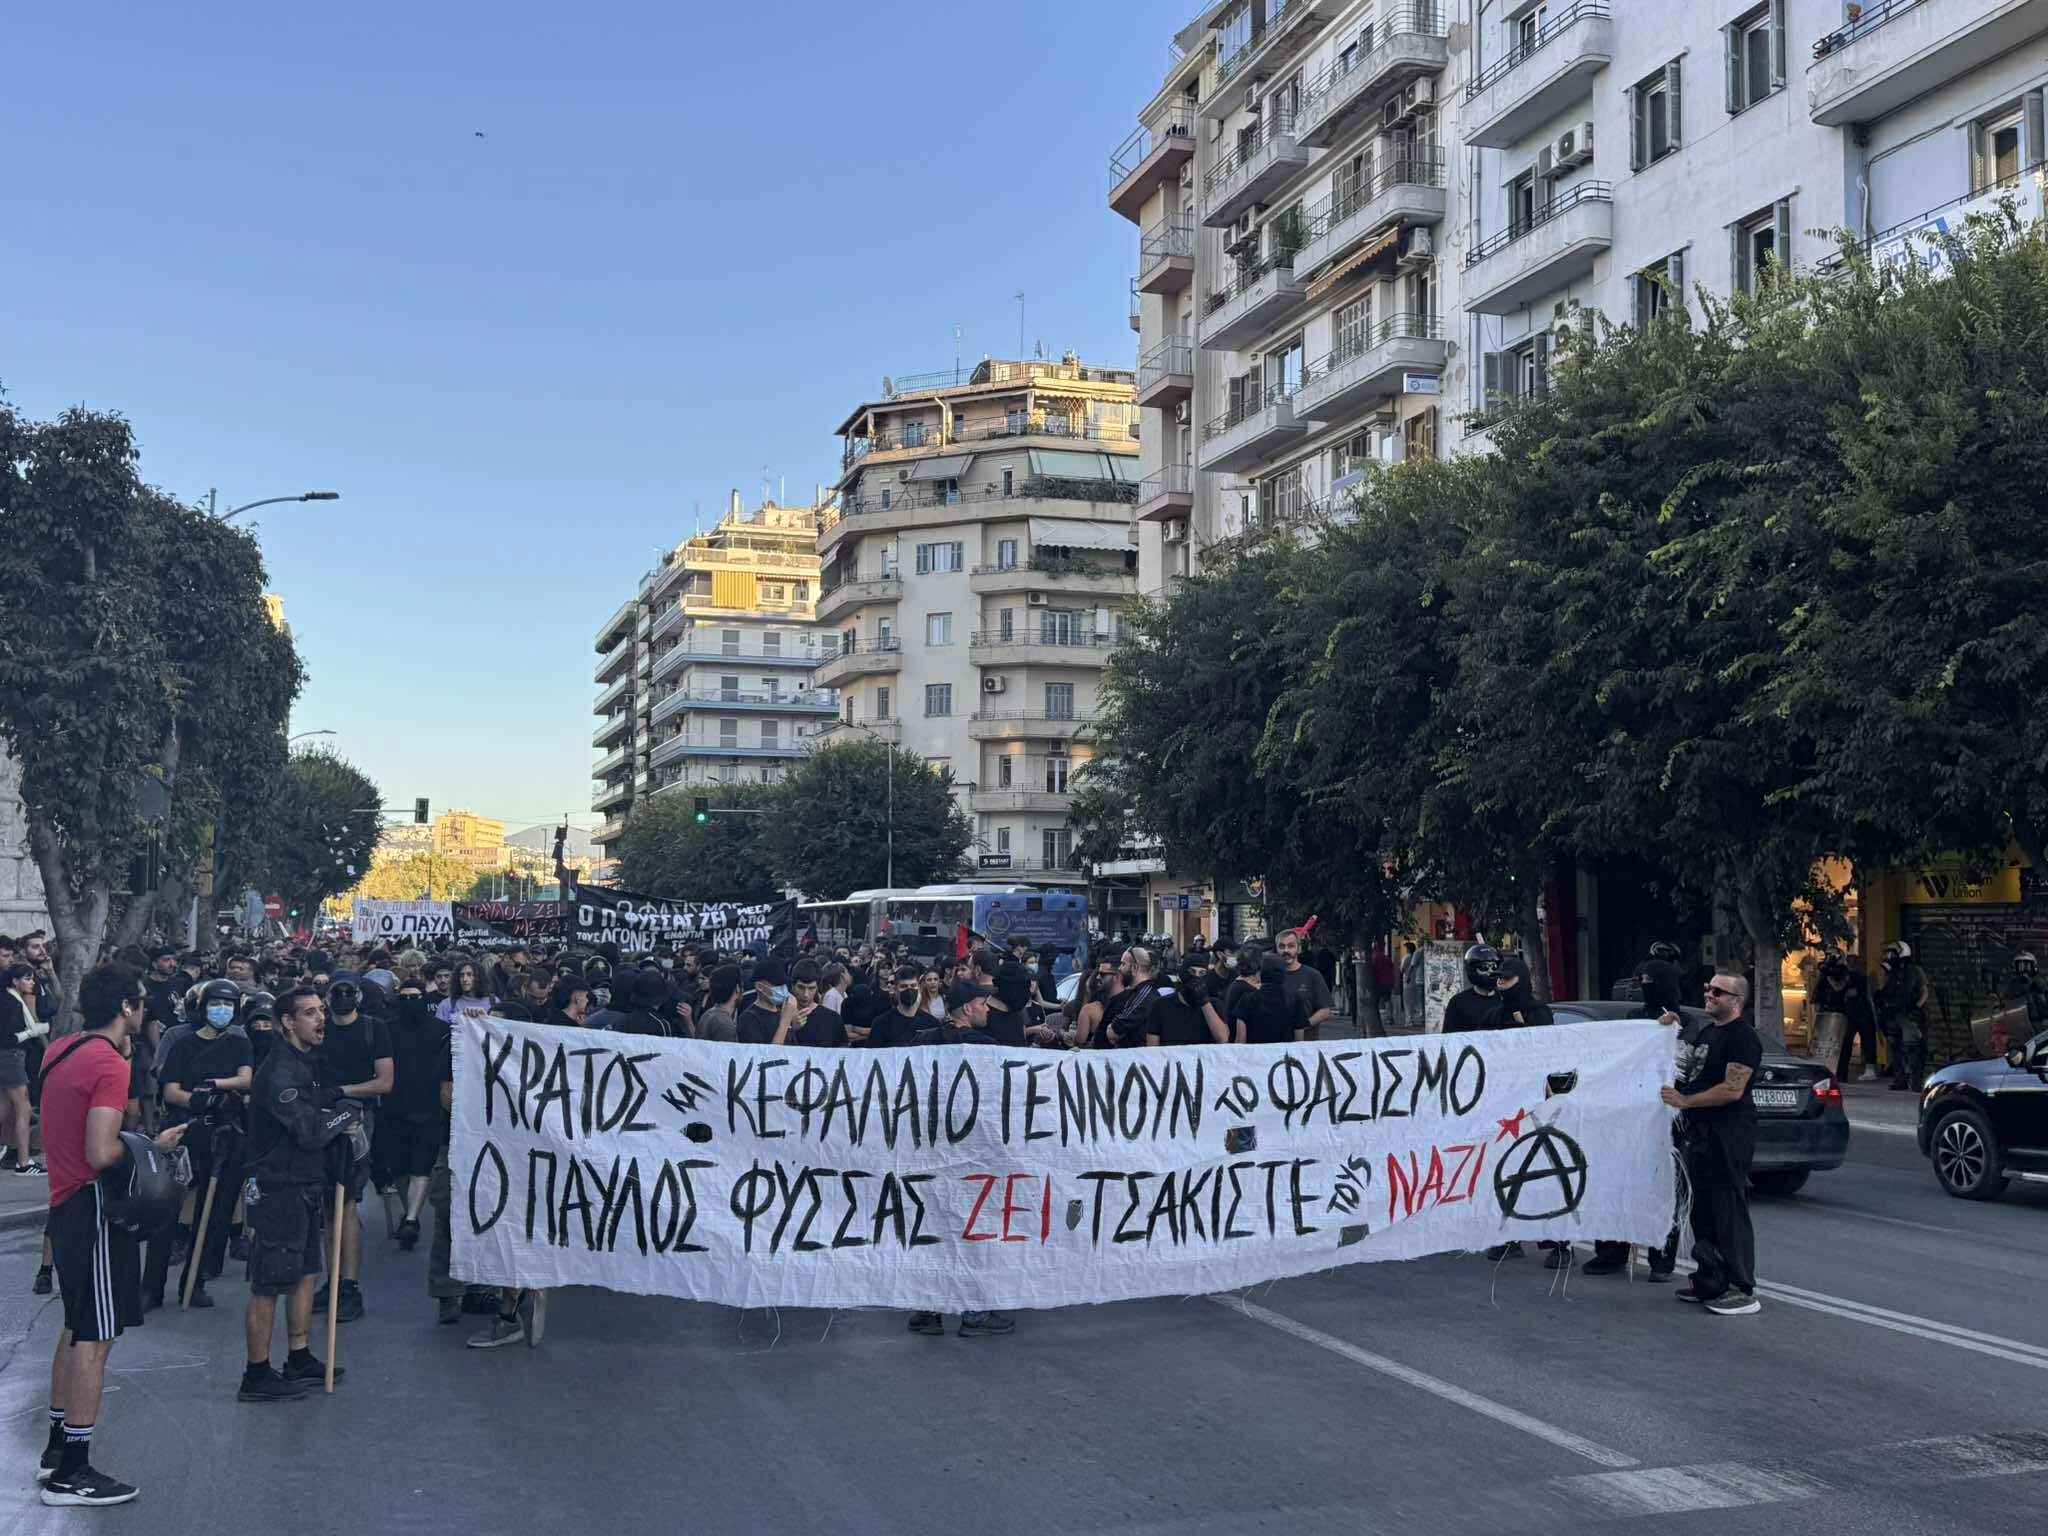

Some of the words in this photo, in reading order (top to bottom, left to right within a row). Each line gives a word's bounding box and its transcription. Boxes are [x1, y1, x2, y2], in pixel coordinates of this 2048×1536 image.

[579, 905, 594, 926] Ο
[699, 911, 727, 930] ΖΕΙ
[1952, 887, 1983, 898] Union
[482, 1031, 663, 1140] ΚΡΑΤΟΣ
[727, 1058, 980, 1149] ΚΕΦΑΛΑΙΟ
[1001, 1059, 1203, 1147] ΓΕΝΝΟΥΝ
[1267, 1045, 1486, 1129] ΦΑΣΙΣΜΟ
[469, 1141, 509, 1236] Ο
[525, 1148, 717, 1256] ΠΑΥΛΟΣ
[730, 1158, 942, 1254] ΦΥΣΣΑΣ
[959, 1174, 1052, 1246] ΖΕΙ
[1076, 1158, 1321, 1249] ΤΣΑΚΙΣΤΕ
[1387, 1143, 1488, 1224] ΝΑΖΙ
